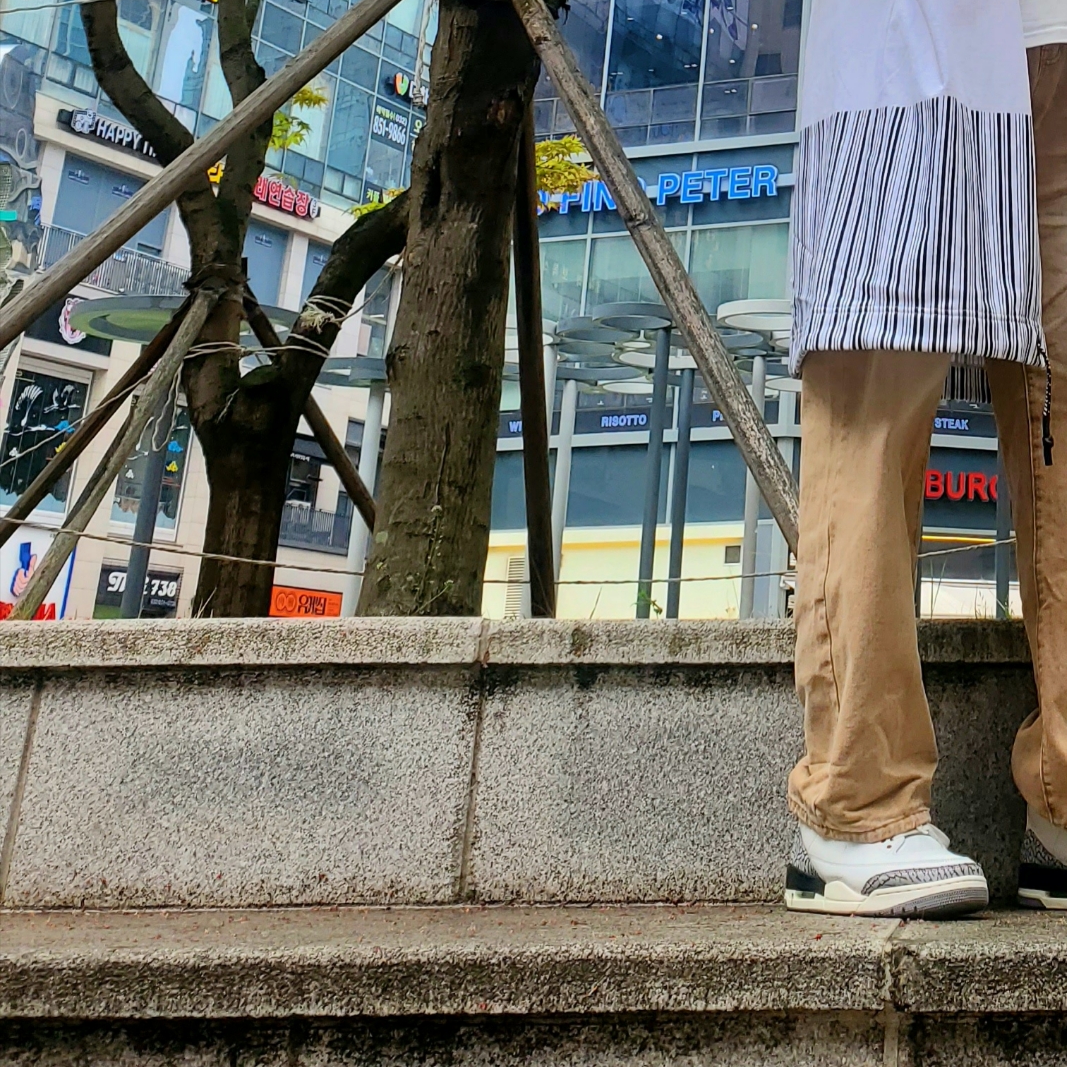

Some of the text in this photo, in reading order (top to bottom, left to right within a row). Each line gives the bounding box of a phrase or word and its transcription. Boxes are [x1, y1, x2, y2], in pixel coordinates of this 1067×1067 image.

[96, 117, 143, 150] HAPPY
[656, 164, 778, 206] PETER
[601, 413, 647, 428] RISOTTO
[934, 417, 969, 430] STEAK
